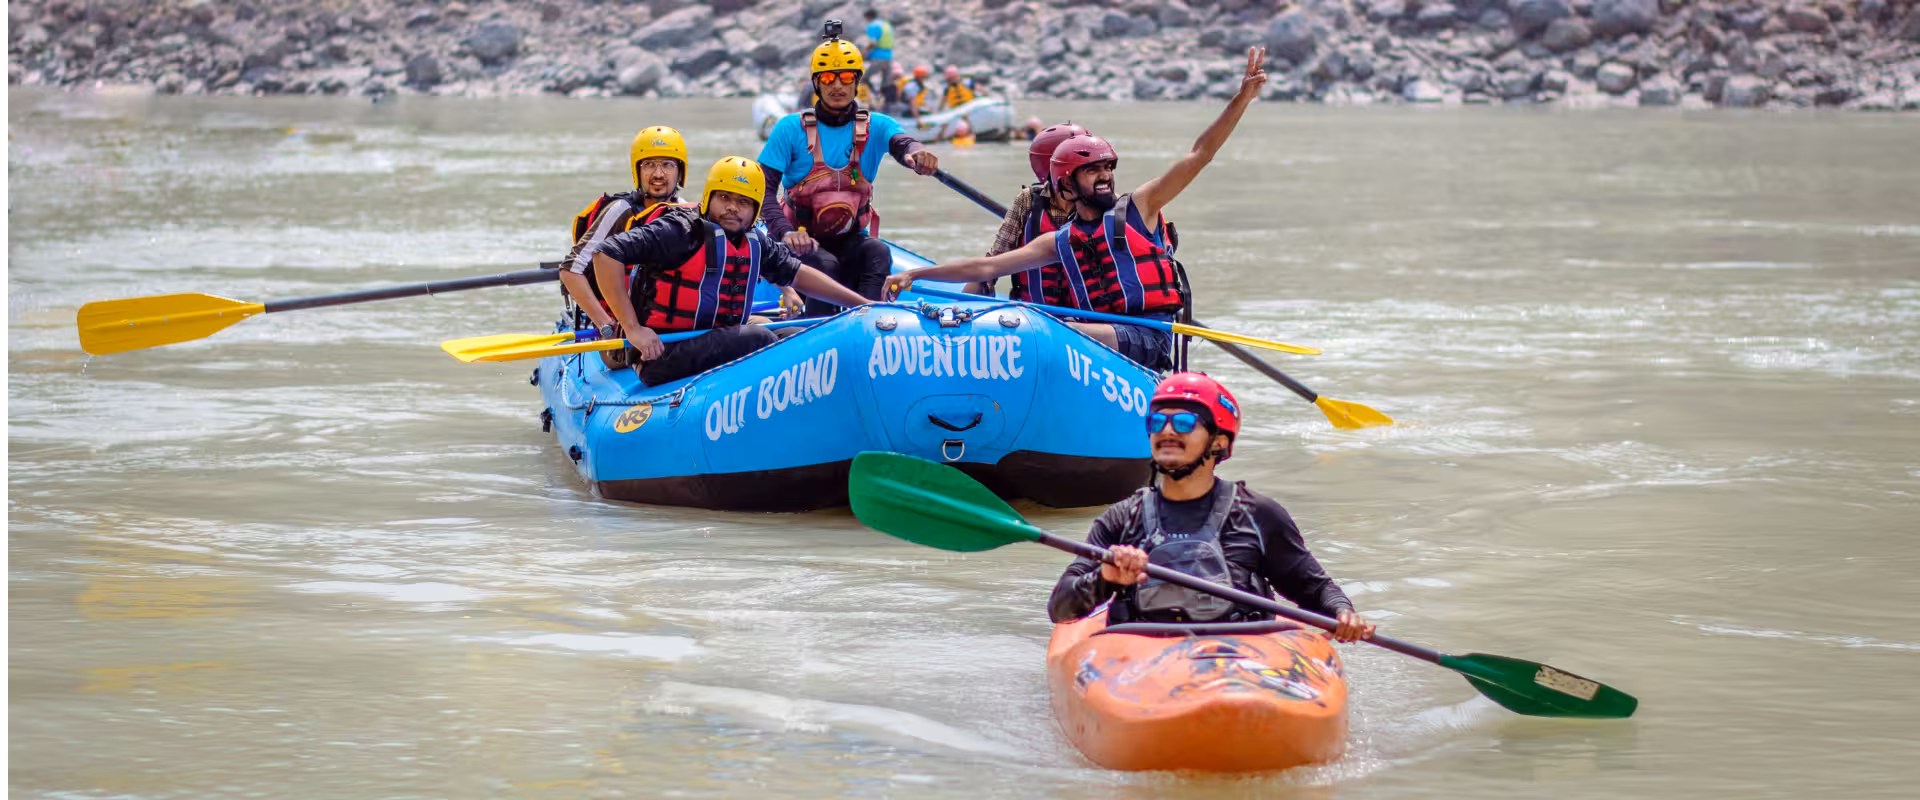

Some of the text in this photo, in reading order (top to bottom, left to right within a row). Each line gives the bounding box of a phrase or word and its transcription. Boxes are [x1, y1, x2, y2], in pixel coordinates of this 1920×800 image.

[705, 334, 1025, 441] OUT BOUND ADVENTURE
[1066, 344, 1148, 417] UT-330
[615, 407, 651, 429] NRS
